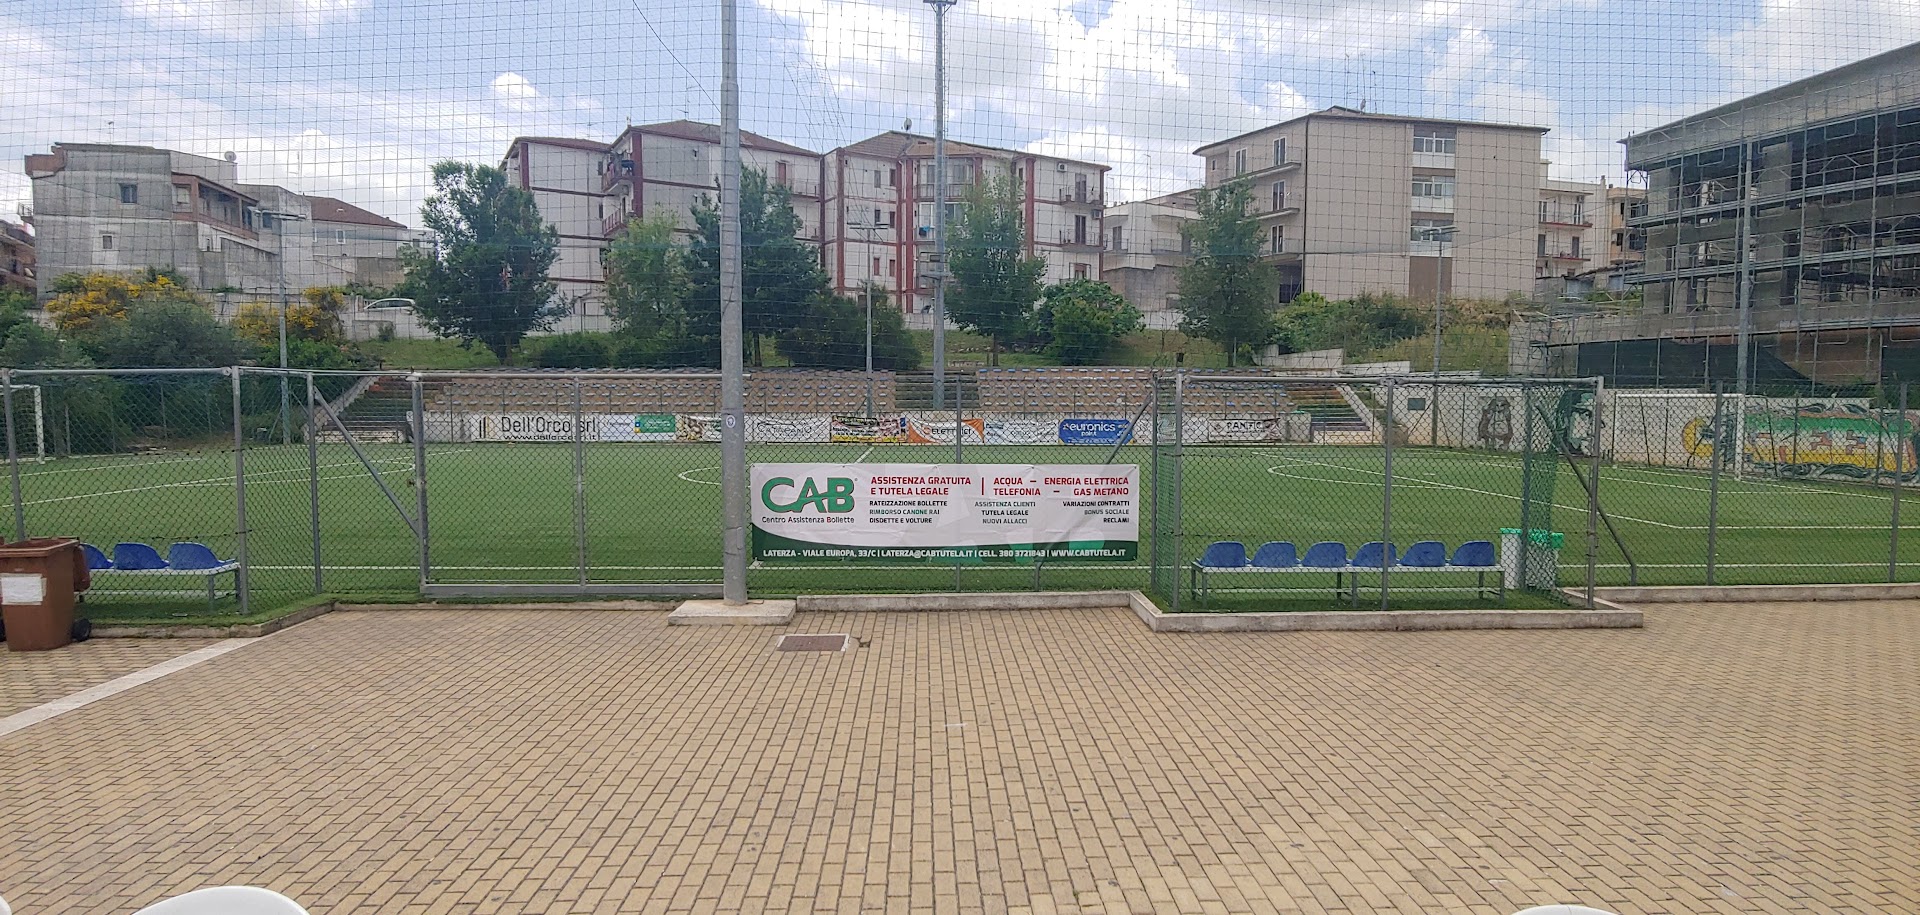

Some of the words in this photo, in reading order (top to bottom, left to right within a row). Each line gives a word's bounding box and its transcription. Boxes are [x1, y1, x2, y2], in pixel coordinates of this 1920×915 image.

[501, 416, 571, 433] Dell'Orco
[579, 416, 596, 433] srl
[1069, 421, 1116, 432] euronics
[871, 476, 926, 485] ASSISTENZA
[928, 476, 971, 485] GRATUITA
[993, 477, 1023, 487] ACQUA
[1044, 477, 1081, 485] ENERGIA
[1083, 477, 1129, 485] ELETTRICA
[761, 477, 855, 513] CAB
[870, 487, 876, 495] E
[878, 487, 913, 495] TUTELA
[915, 487, 949, 495] LEGALE
[993, 488, 1041, 496] TELEFONIA
[1073, 488, 1091, 496] GAS
[1093, 487, 1129, 496] METANO
[763, 549, 797, 557] LATERZA
[803, 549, 825, 557] VIALE
[826, 549, 857, 558] EUROPA,
[858, 549, 876, 557] 33/C
[881, 549, 973, 558] LATERZA@CABTUTELA.IT
[999, 549, 1014, 557] 380
[1014, 549, 1046, 557] 3721843
[1051, 549, 1126, 557] WWW.CABTUTELA.IT
